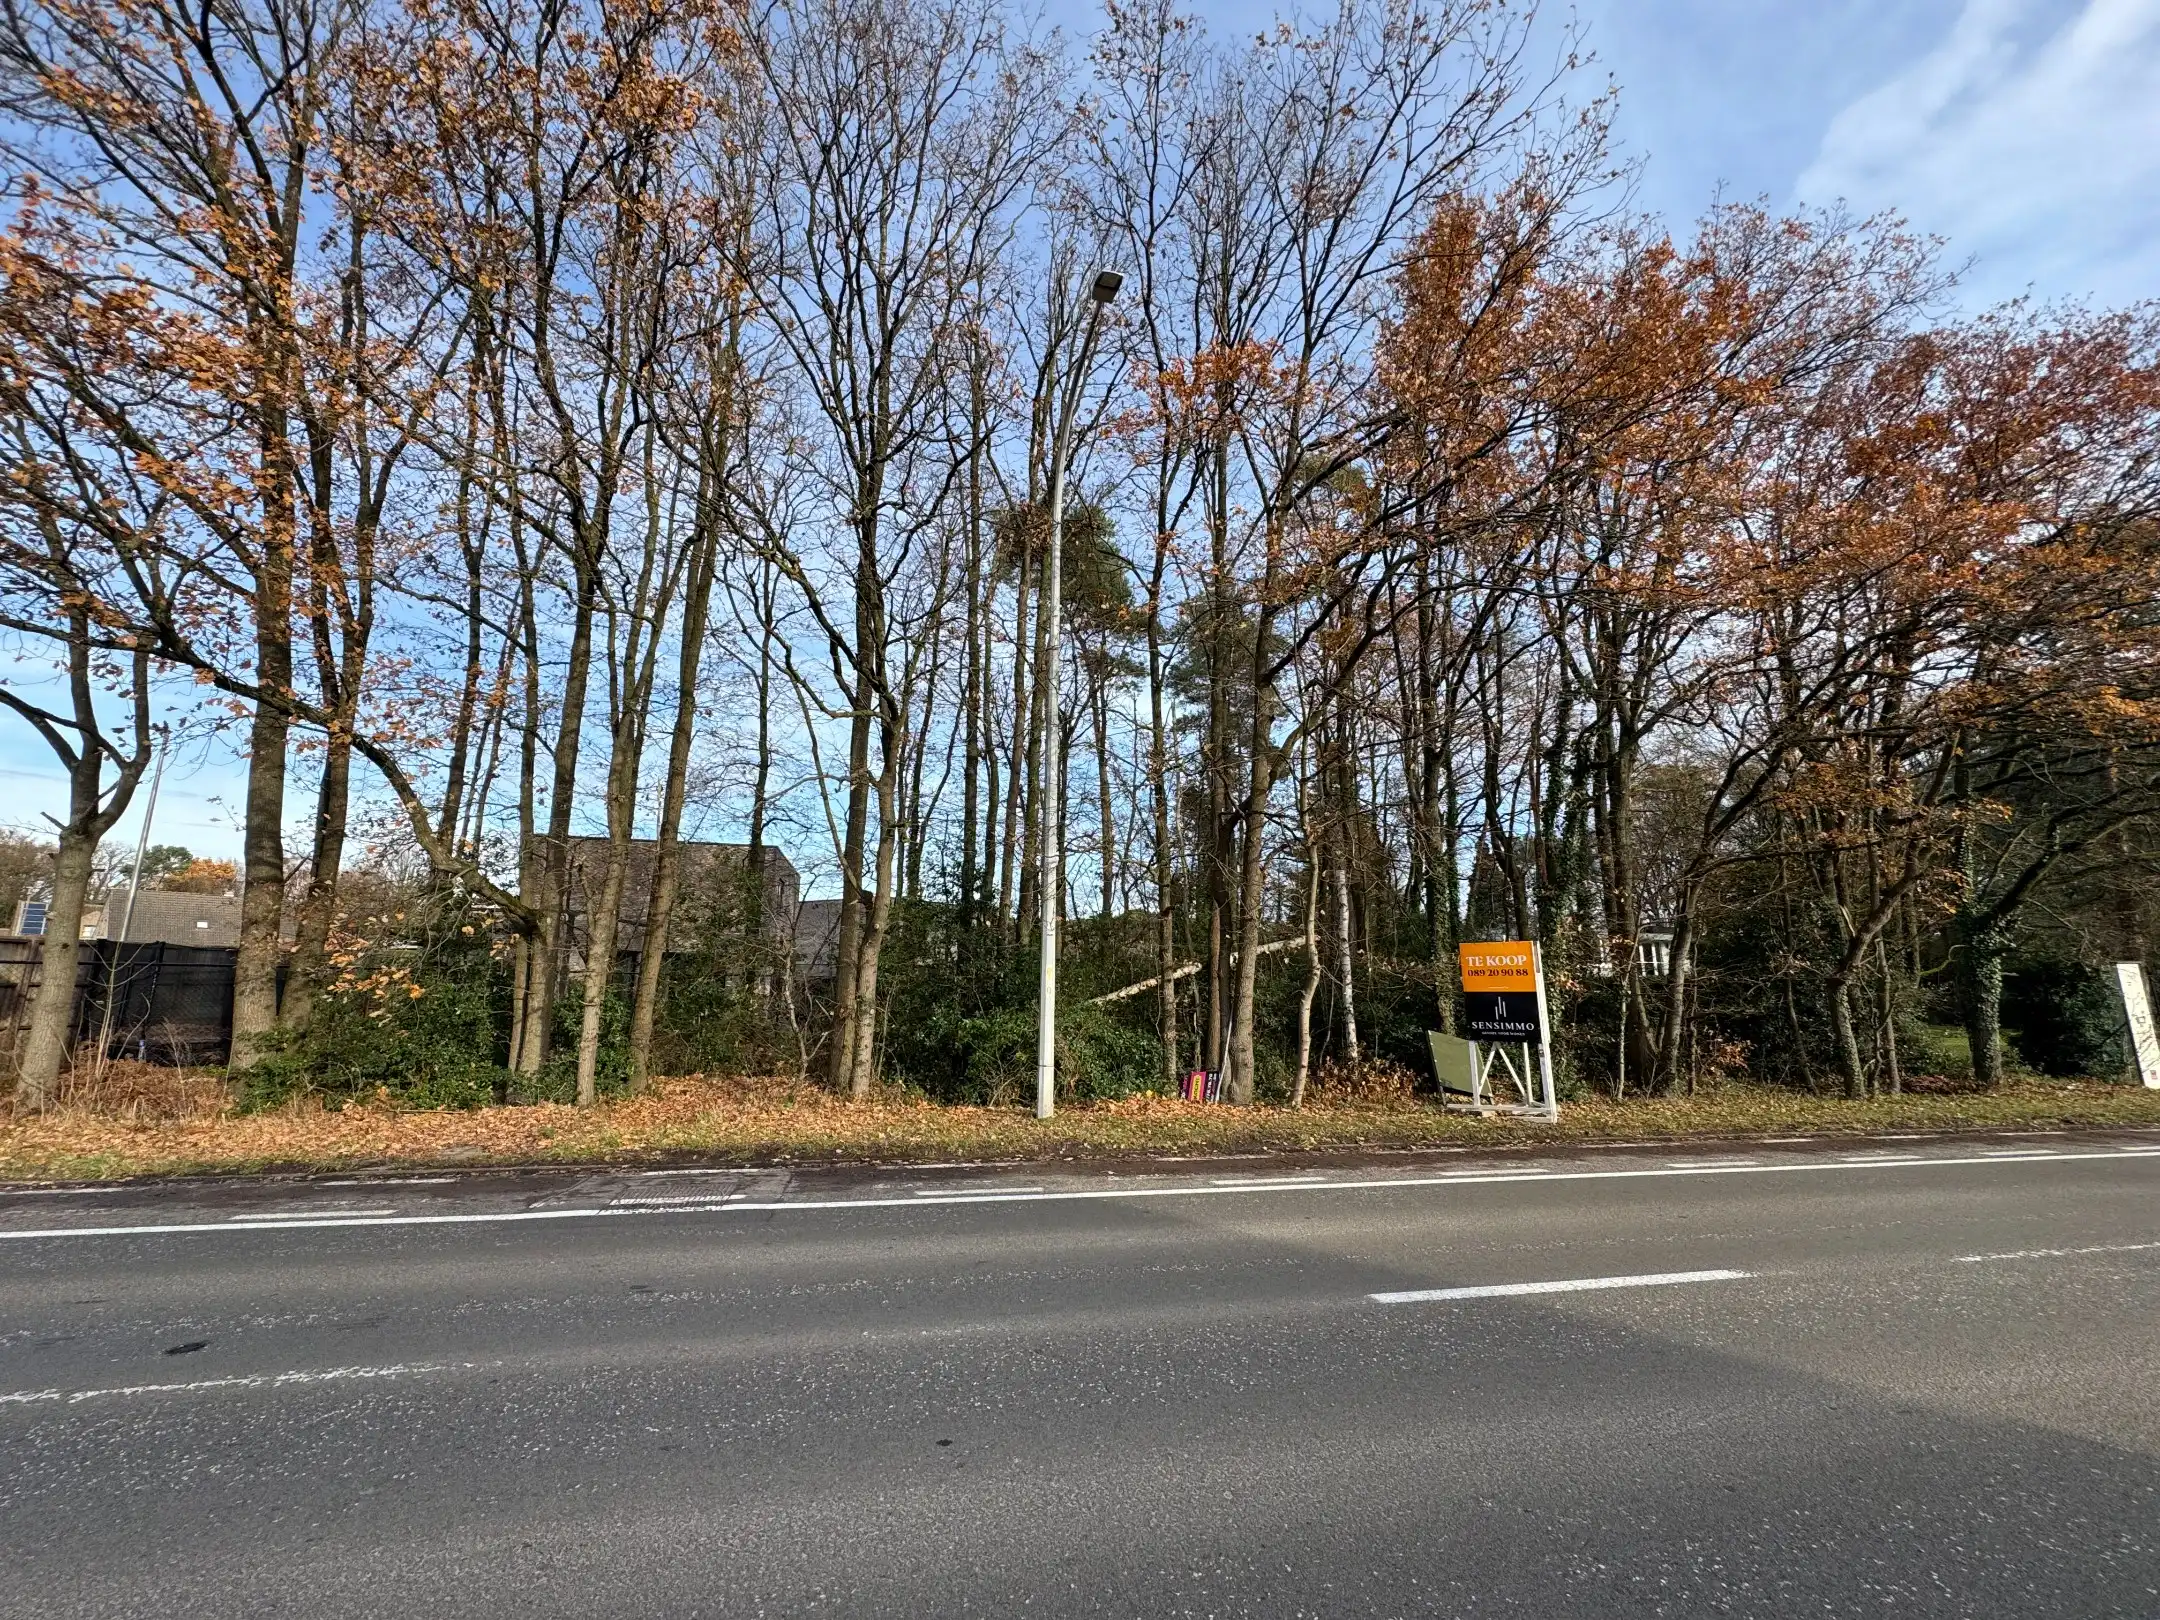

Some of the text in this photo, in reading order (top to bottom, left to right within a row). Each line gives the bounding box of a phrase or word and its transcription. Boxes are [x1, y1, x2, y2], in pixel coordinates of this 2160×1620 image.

[1466, 954, 1527, 967] TE KOOP
[1467, 969, 1486, 977] 089
[1472, 1021, 1535, 1031] SENSIMMO
